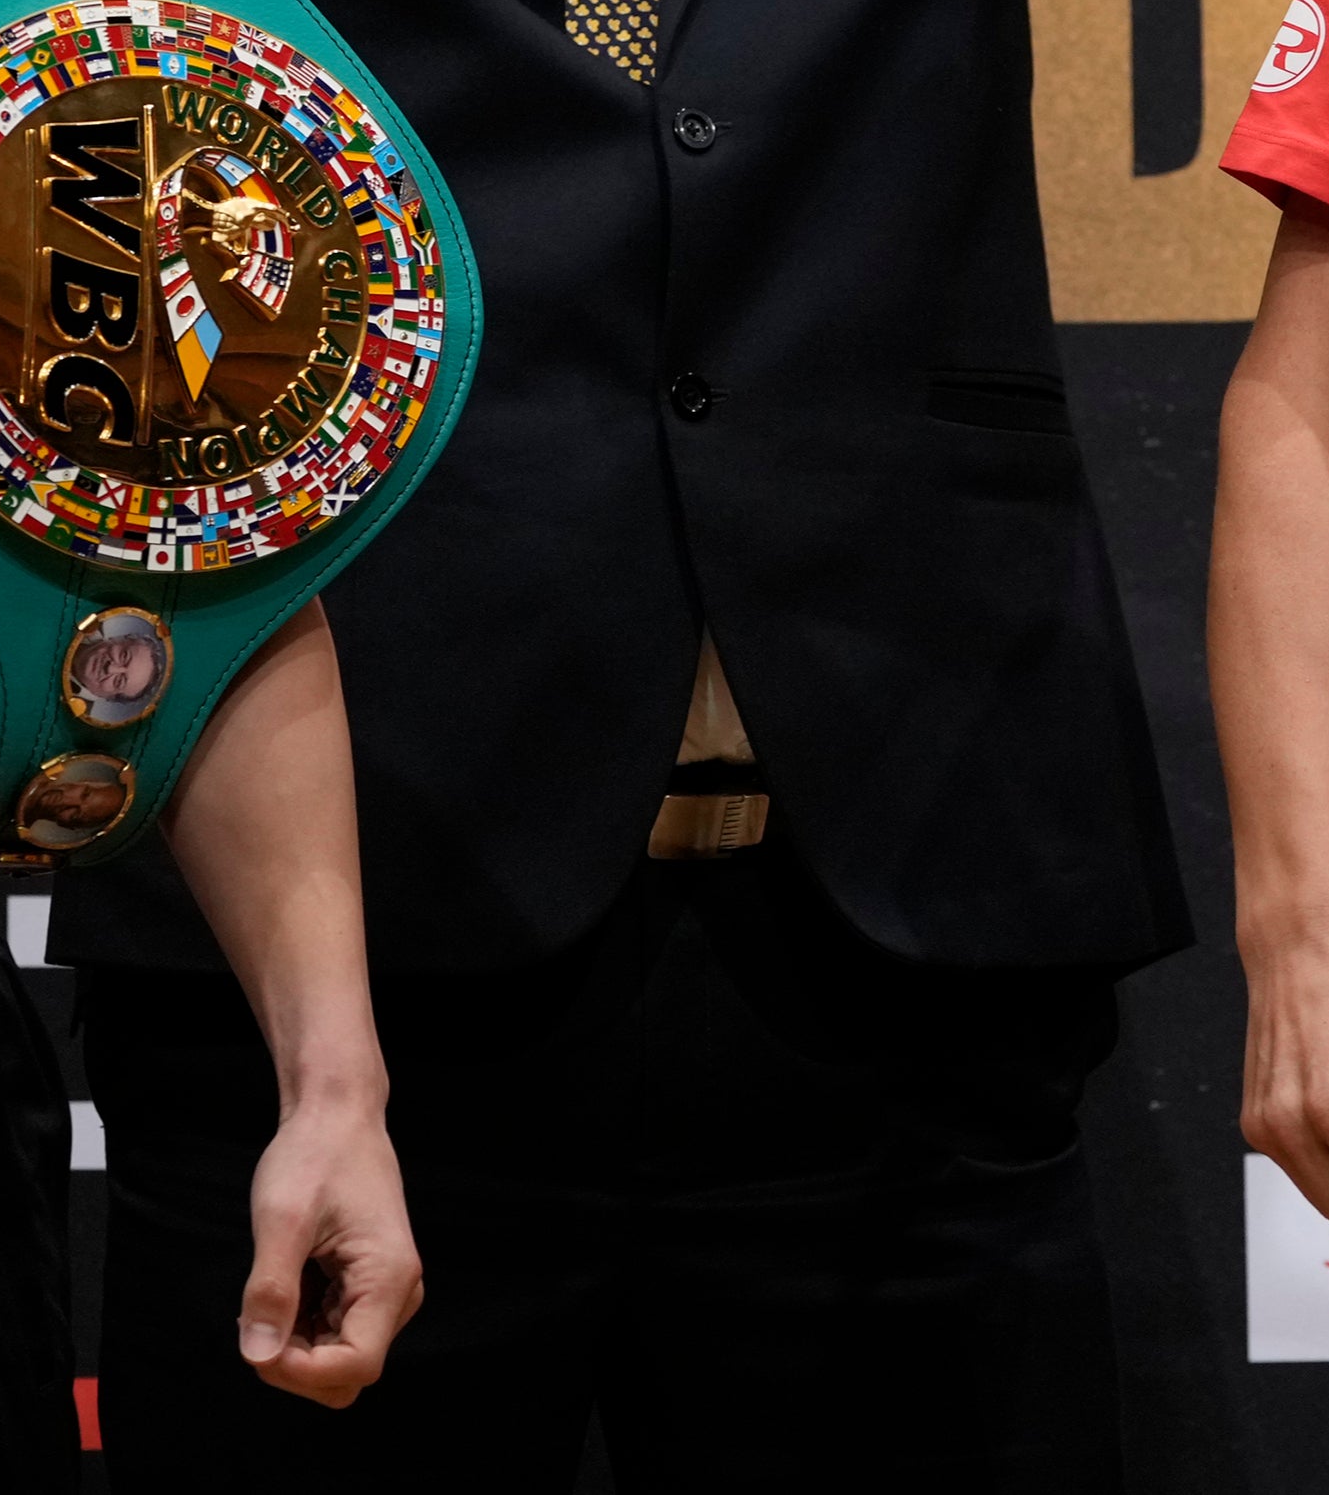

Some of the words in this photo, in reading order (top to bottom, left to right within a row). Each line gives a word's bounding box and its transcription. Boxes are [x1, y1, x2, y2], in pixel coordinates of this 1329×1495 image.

[162, 84, 339, 228] WORLD
[39, 118, 142, 447] WBC
[158, 249, 363, 481] CHAMPION
